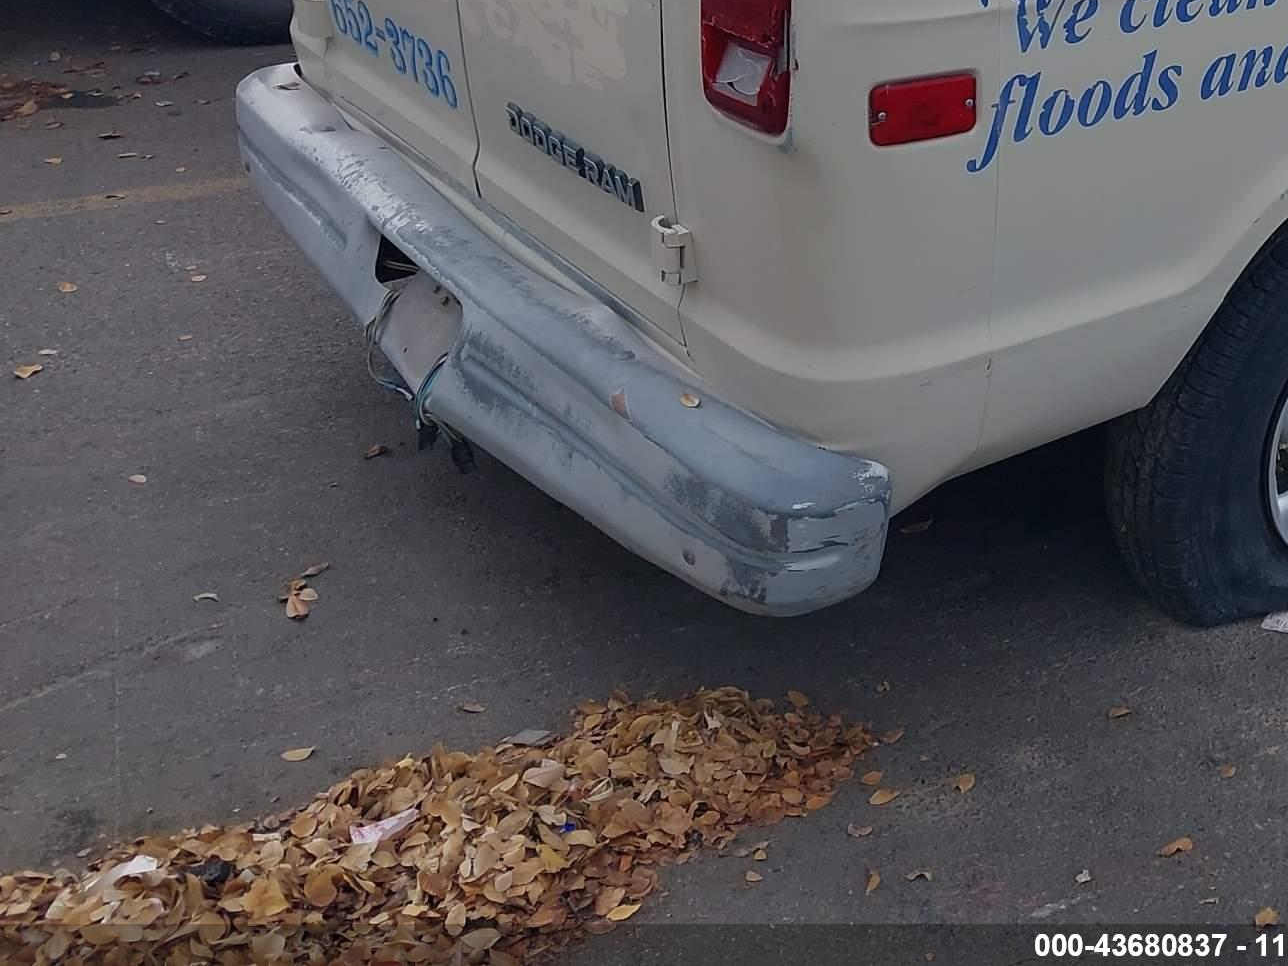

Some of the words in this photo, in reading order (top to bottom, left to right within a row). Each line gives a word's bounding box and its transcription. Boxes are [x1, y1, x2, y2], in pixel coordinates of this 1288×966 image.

[505, 100, 585, 172] DODGE
[580, 147, 645, 213] RAM
[965, 50, 1183, 174] floods
